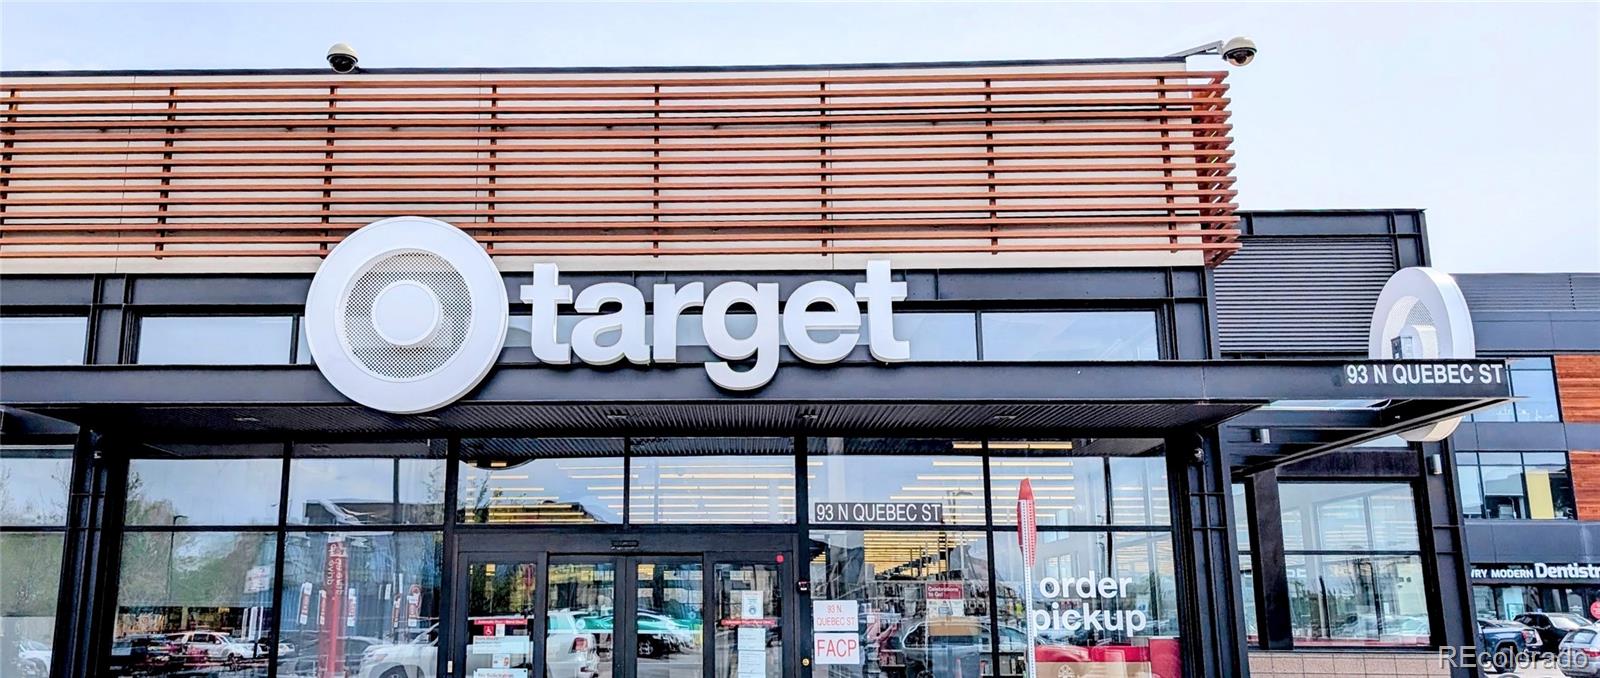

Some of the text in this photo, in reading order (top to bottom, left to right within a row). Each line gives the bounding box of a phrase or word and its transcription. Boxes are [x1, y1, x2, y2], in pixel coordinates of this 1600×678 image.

[520, 260, 910, 391] target
[1346, 363, 1503, 385] 93 N QUEBEC ST
[816, 503, 941, 522] 93 N QUEBEC ST
[1491, 569, 1534, 578] MODERN
[1040, 570, 1132, 599] order
[827, 605, 842, 613] 93 N
[816, 617, 856, 626] QUEBEC ST
[1032, 602, 1147, 637] pickup
[817, 639, 857, 657] FACP
